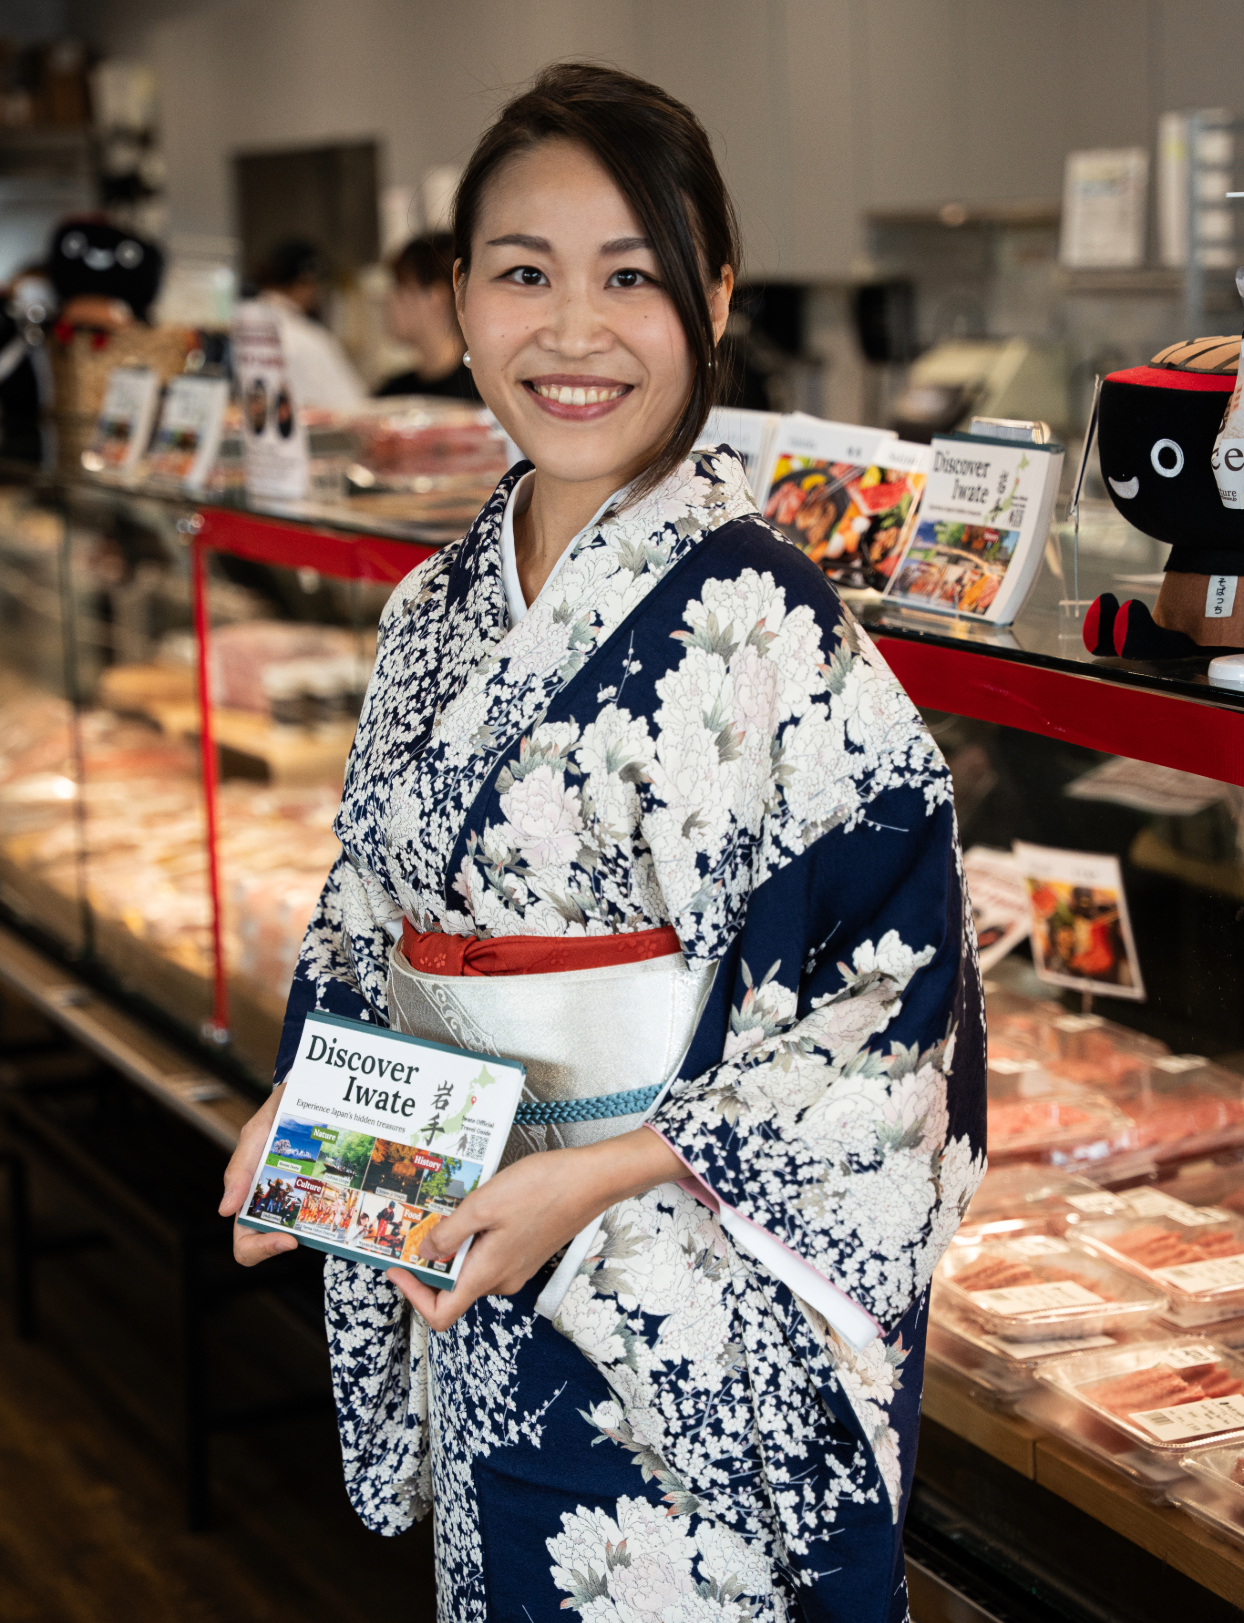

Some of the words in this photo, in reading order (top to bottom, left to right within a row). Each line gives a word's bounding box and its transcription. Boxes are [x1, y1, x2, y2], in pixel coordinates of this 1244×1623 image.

[934, 450, 991, 478] Discover
[952, 478, 989, 504] Iwate
[1213, 577, 1226, 615] そばっち
[305, 1034, 419, 1084] Discover
[342, 1075, 416, 1117] Iwate
[296, 1098, 330, 1113] Experience
[331, 1107, 353, 1119] Japan's
[354, 1113, 375, 1125] hidden
[376, 1120, 405, 1133] treasures
[420, 1080, 454, 1147] 岩手
[476, 1119, 494, 1128] Official
[313, 1128, 336, 1141] Nature
[460, 1123, 476, 1133] Travel
[476, 1128, 491, 1137] Guide
[414, 1155, 442, 1171] History
[296, 1179, 321, 1192] Culture
[403, 1208, 422, 1221] Food
